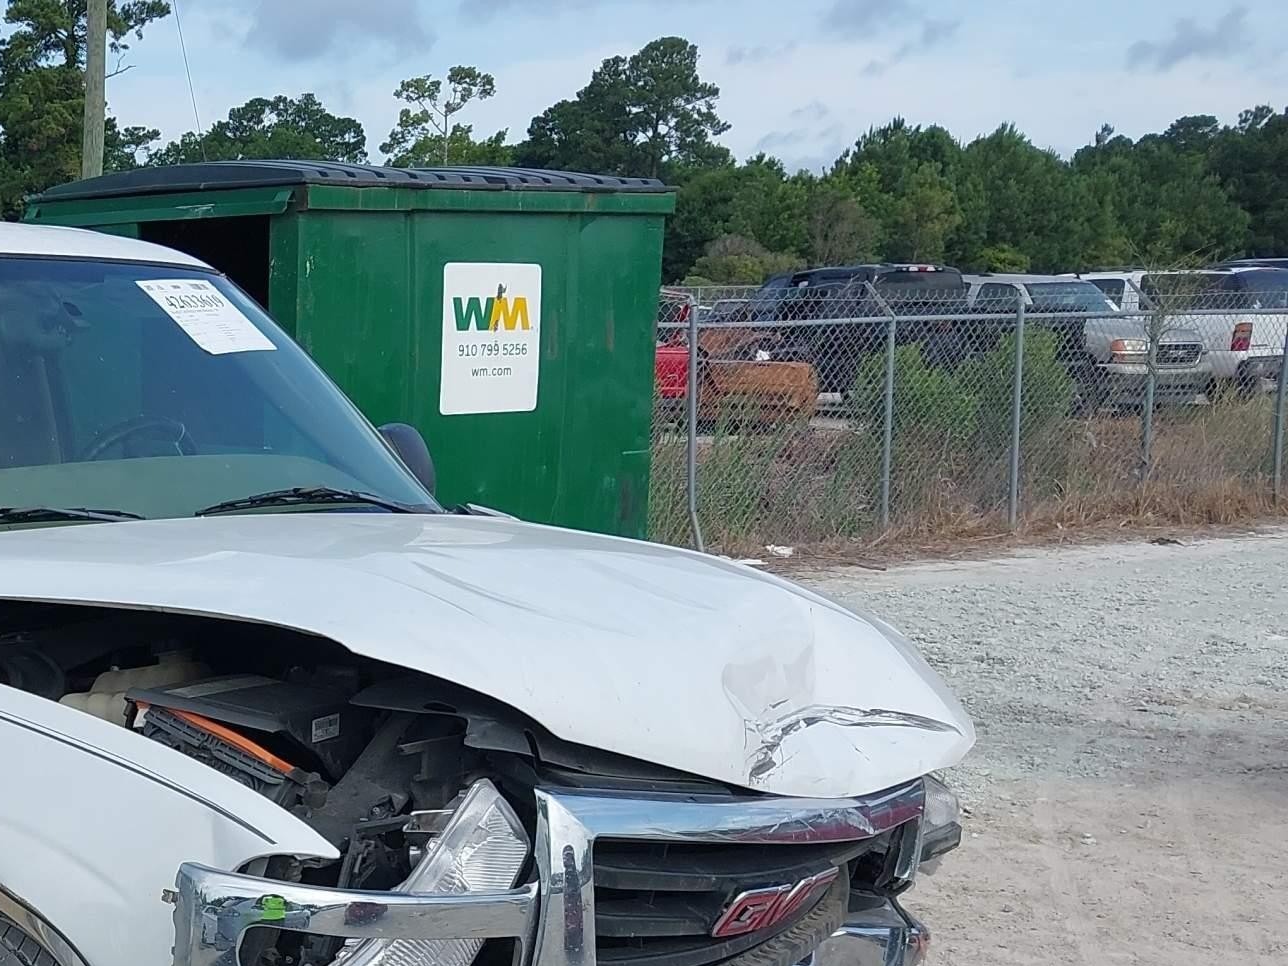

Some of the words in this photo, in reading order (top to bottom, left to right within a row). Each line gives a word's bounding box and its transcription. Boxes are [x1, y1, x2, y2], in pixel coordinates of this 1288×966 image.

[453, 297, 530, 331] WM
[458, 345, 478, 357] 910
[481, 344, 500, 356] 799
[502, 344, 528, 356] 5256
[471, 367, 512, 377] wm.com
